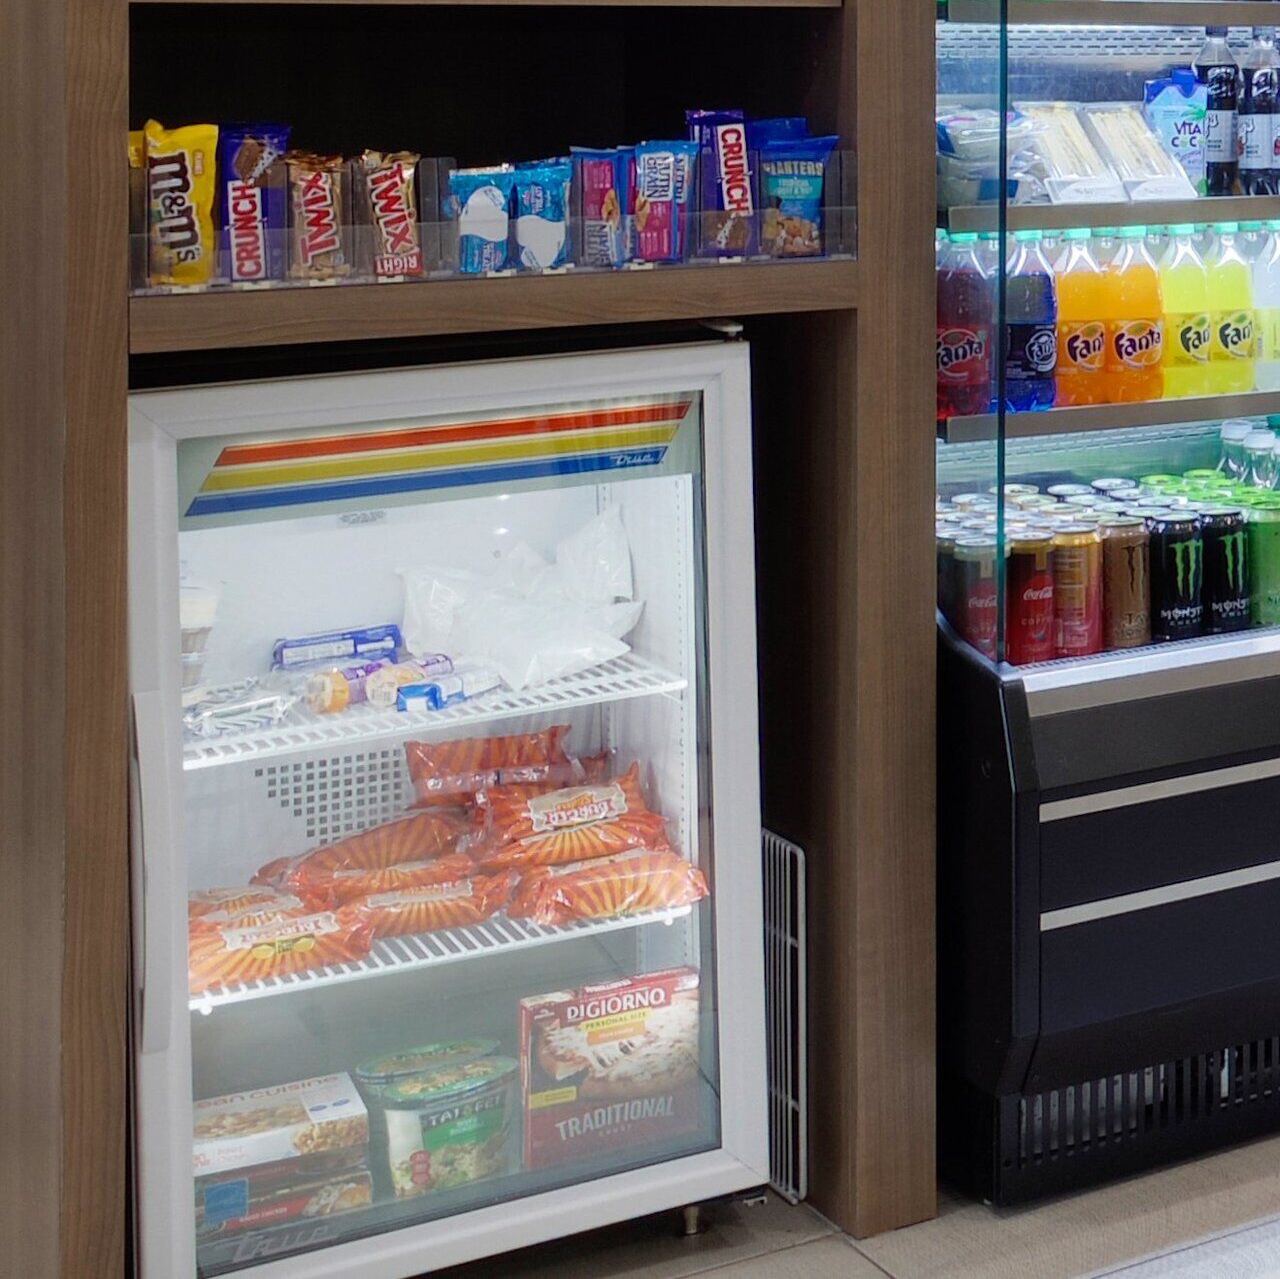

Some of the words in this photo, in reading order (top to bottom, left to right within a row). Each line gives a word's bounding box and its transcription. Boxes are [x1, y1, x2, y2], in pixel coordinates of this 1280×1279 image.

[1174, 122, 1203, 135] VITA
[720, 127, 750, 216] CRUNCH
[232, 186, 262, 277] CRUNCH
[374, 252, 419, 275] RIGHT
[1114, 328, 1161, 361] Fanta
[566, 988, 666, 1020] DIGIORNO
[585, 1016, 628, 1029] PERSONAL
[250, 1075, 340, 1098] cuisine
[555, 1095, 674, 1141] TRADITIONAL
